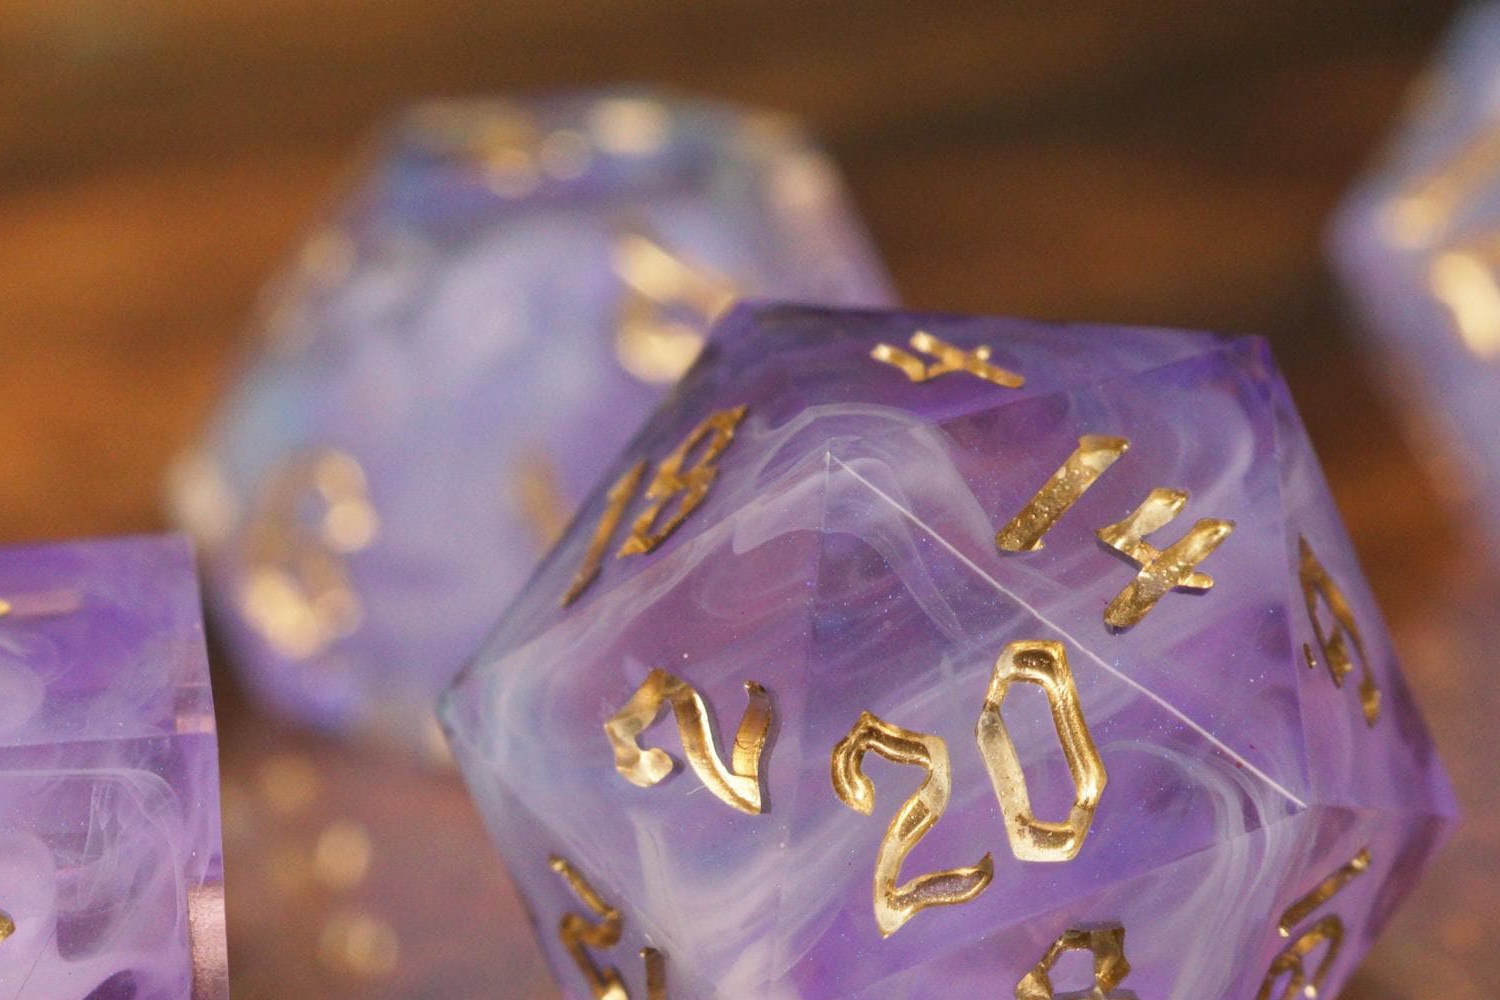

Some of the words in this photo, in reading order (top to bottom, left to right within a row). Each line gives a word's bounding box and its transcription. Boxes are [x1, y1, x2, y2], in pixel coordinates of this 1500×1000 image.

[871, 331, 1026, 388] 4
[558, 403, 749, 608] 18
[994, 434, 1236, 629] 14
[603, 668, 773, 815] 2
[830, 639, 1108, 939] 20
